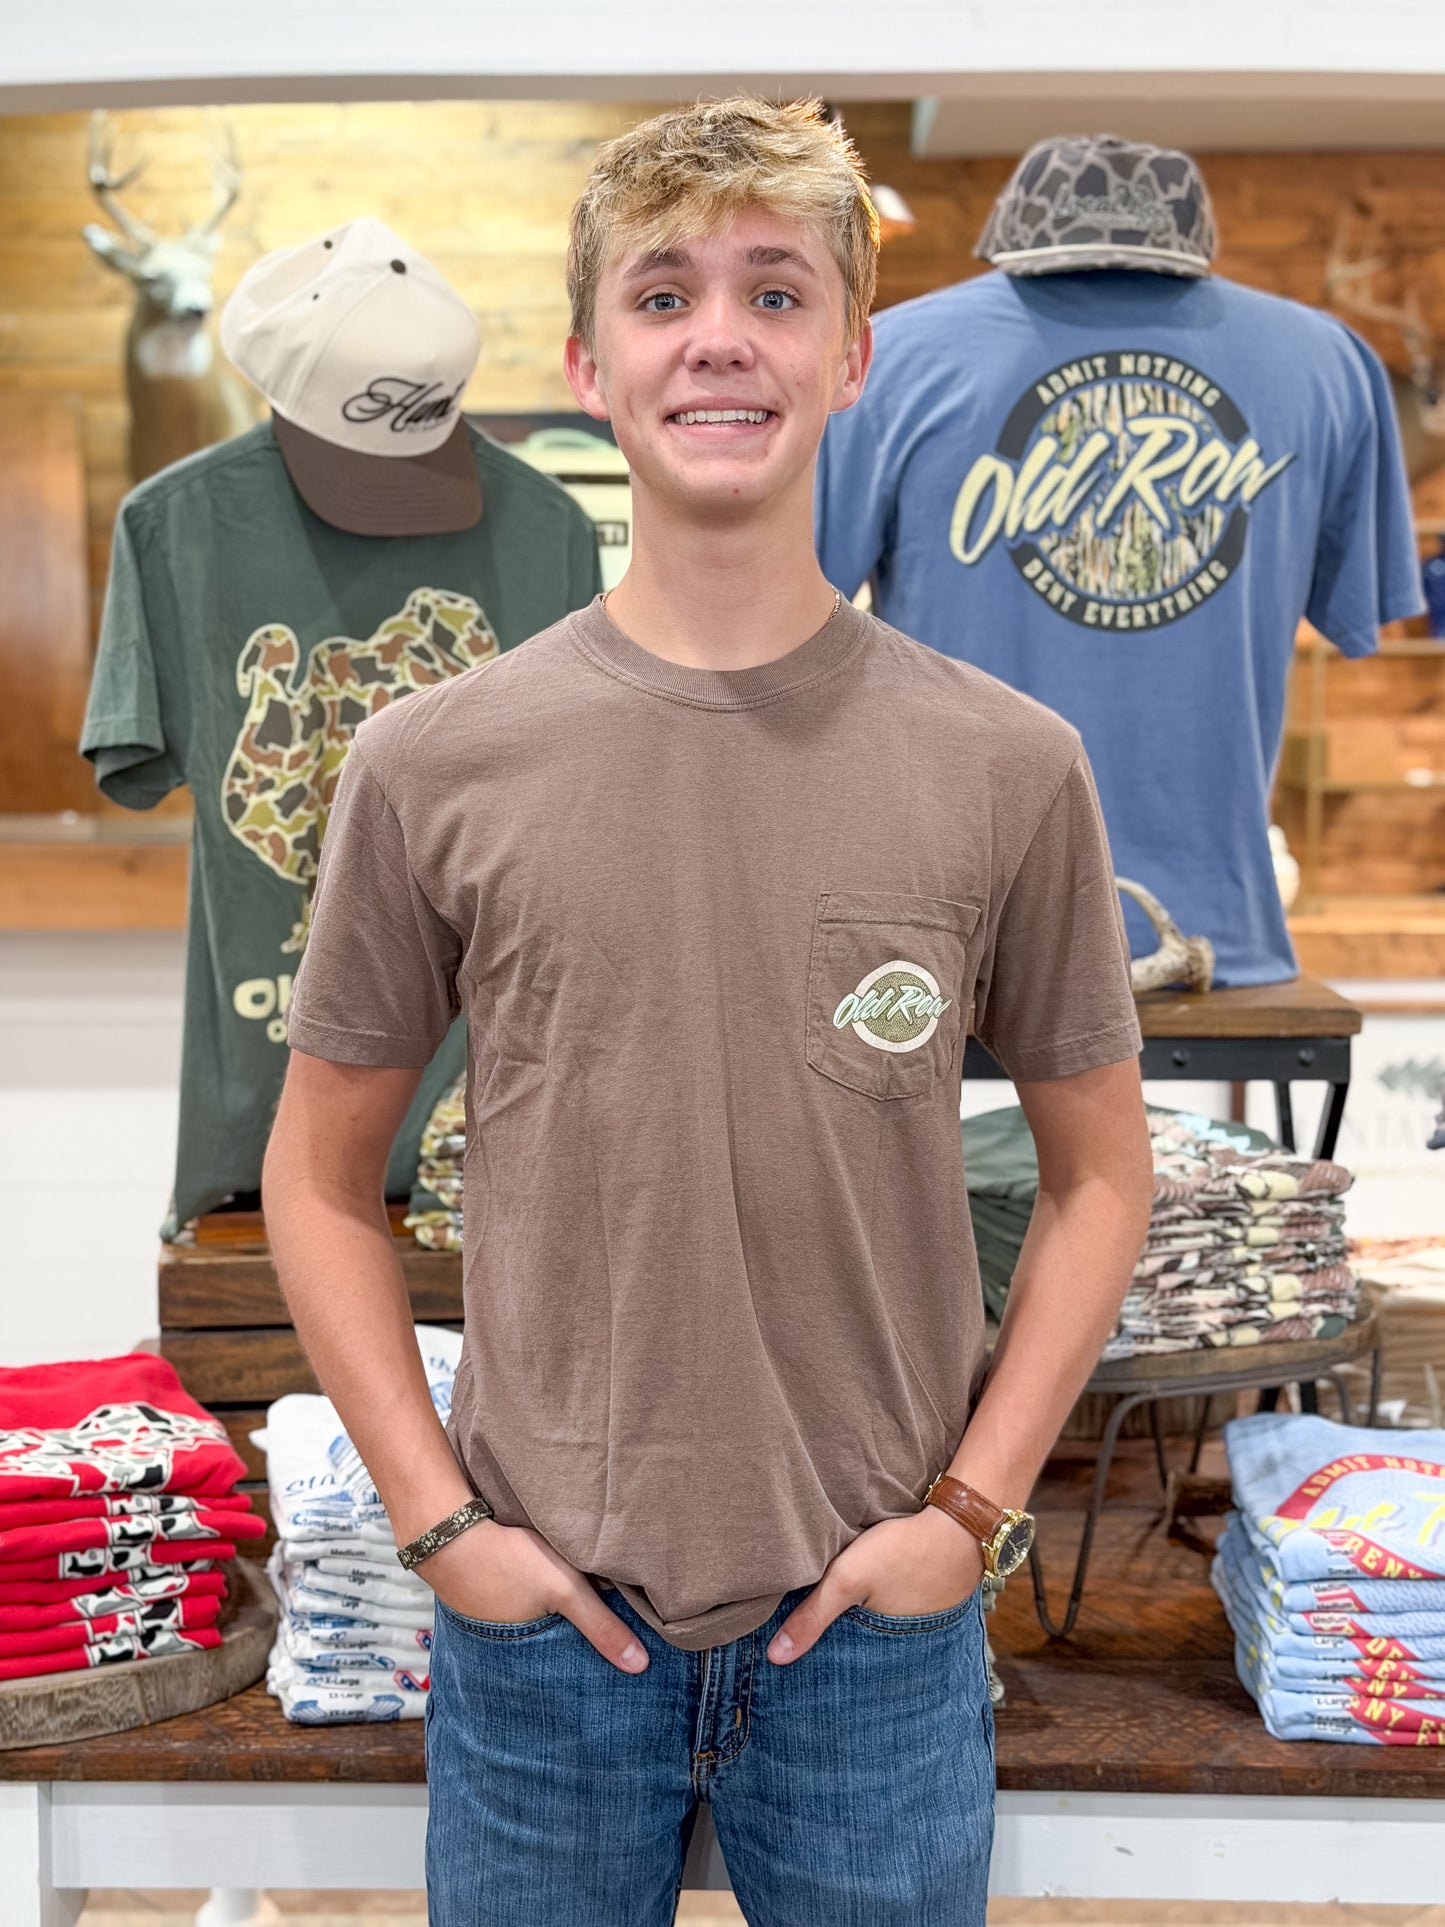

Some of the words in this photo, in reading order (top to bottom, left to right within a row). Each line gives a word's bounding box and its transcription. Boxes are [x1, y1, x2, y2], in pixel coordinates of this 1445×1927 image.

[1036, 356, 1107, 405] ADMIT
[1120, 354, 1221, 407] NOTHING
[950, 431, 1106, 565] Old
[1096, 416, 1296, 529] Row
[1022, 557, 1078, 614] DENY
[1084, 559, 1229, 629] EVERYTHING
[833, 987, 895, 1029] Old
[887, 985, 953, 1025] Row
[1302, 1456, 1371, 1497] ADMIT
[324, 1522, 353, 1531] Small
[330, 1549, 366, 1557] Medium
[351, 1569, 386, 1580] Medium
[1327, 1567, 1358, 1576] Small
[1313, 1615, 1348, 1624] Medium
[335, 1658, 370, 1667] X-Large
[325, 1676, 360, 1686] X-Large
